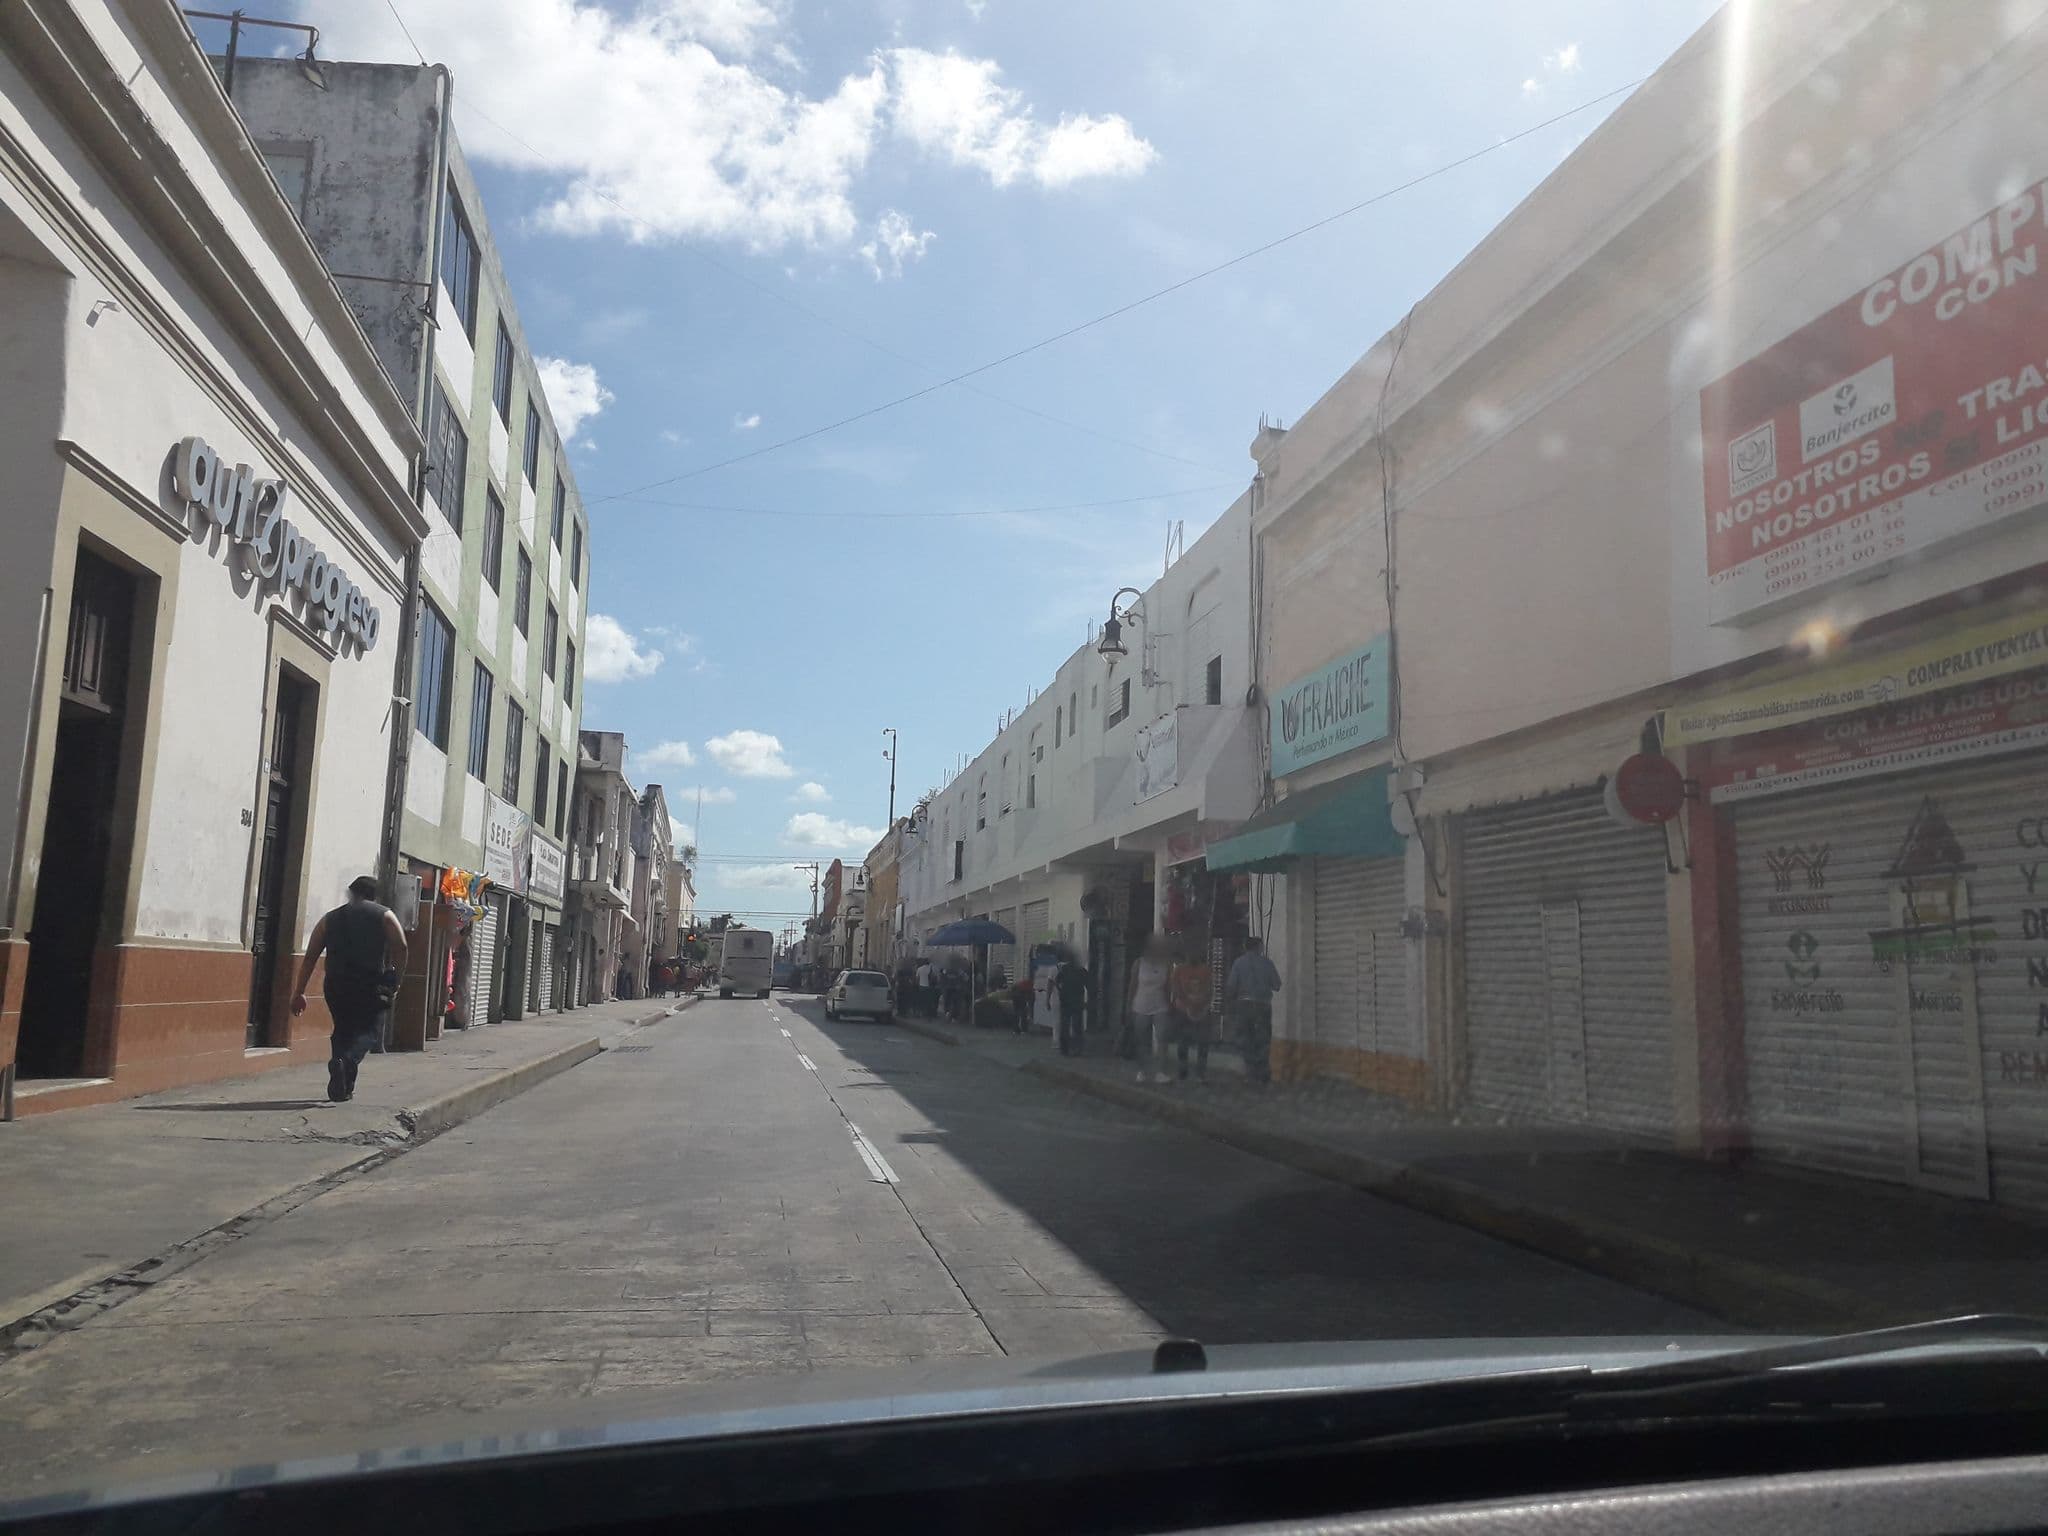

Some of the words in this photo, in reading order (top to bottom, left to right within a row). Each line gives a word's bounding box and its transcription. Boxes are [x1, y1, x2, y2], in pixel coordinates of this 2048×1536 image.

[1861, 178, 2048, 327] COMP
[1935, 243, 2037, 321] CON
[1715, 439, 1881, 534] NOSOTROS
[1957, 358, 2048, 420] TRA
[1806, 402, 1892, 452] Banjercito
[1750, 451, 1932, 549] NOSOTROS
